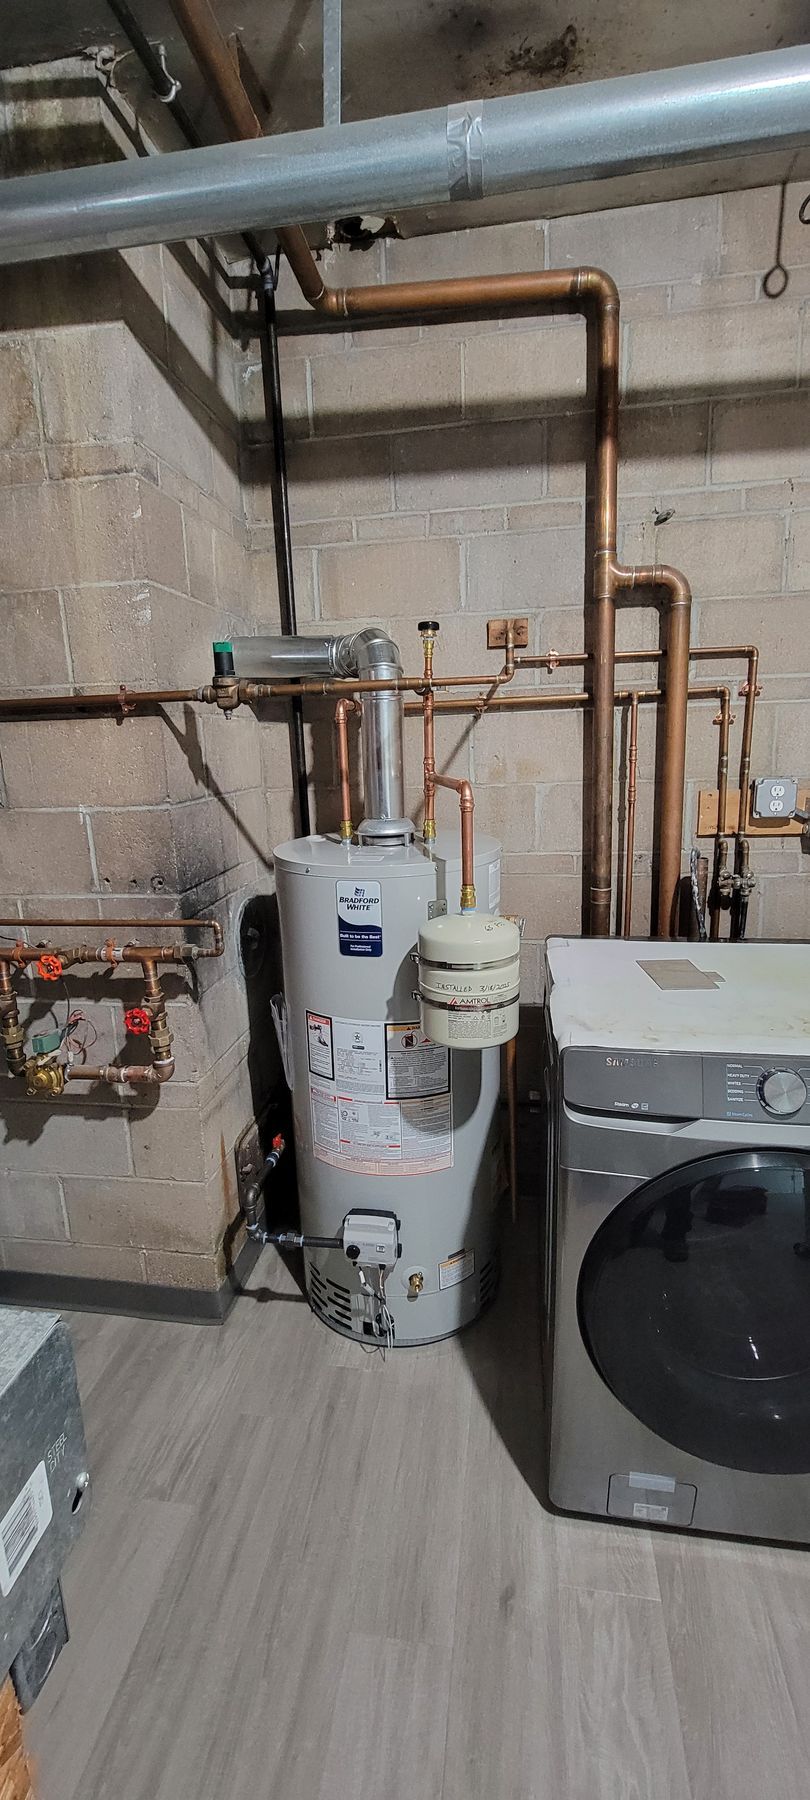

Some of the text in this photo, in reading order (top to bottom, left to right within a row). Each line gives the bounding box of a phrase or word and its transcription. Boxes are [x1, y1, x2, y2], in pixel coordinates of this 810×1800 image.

[339, 896, 380, 904] BRADFORD
[436, 982, 473, 992] INSTALLED
[459, 997, 491, 1005] AMTROL
[606, 1057, 659, 1068] SAMS
[48, 1432, 67, 1463] STEEL
[50, 1444, 65, 1473] CITY
